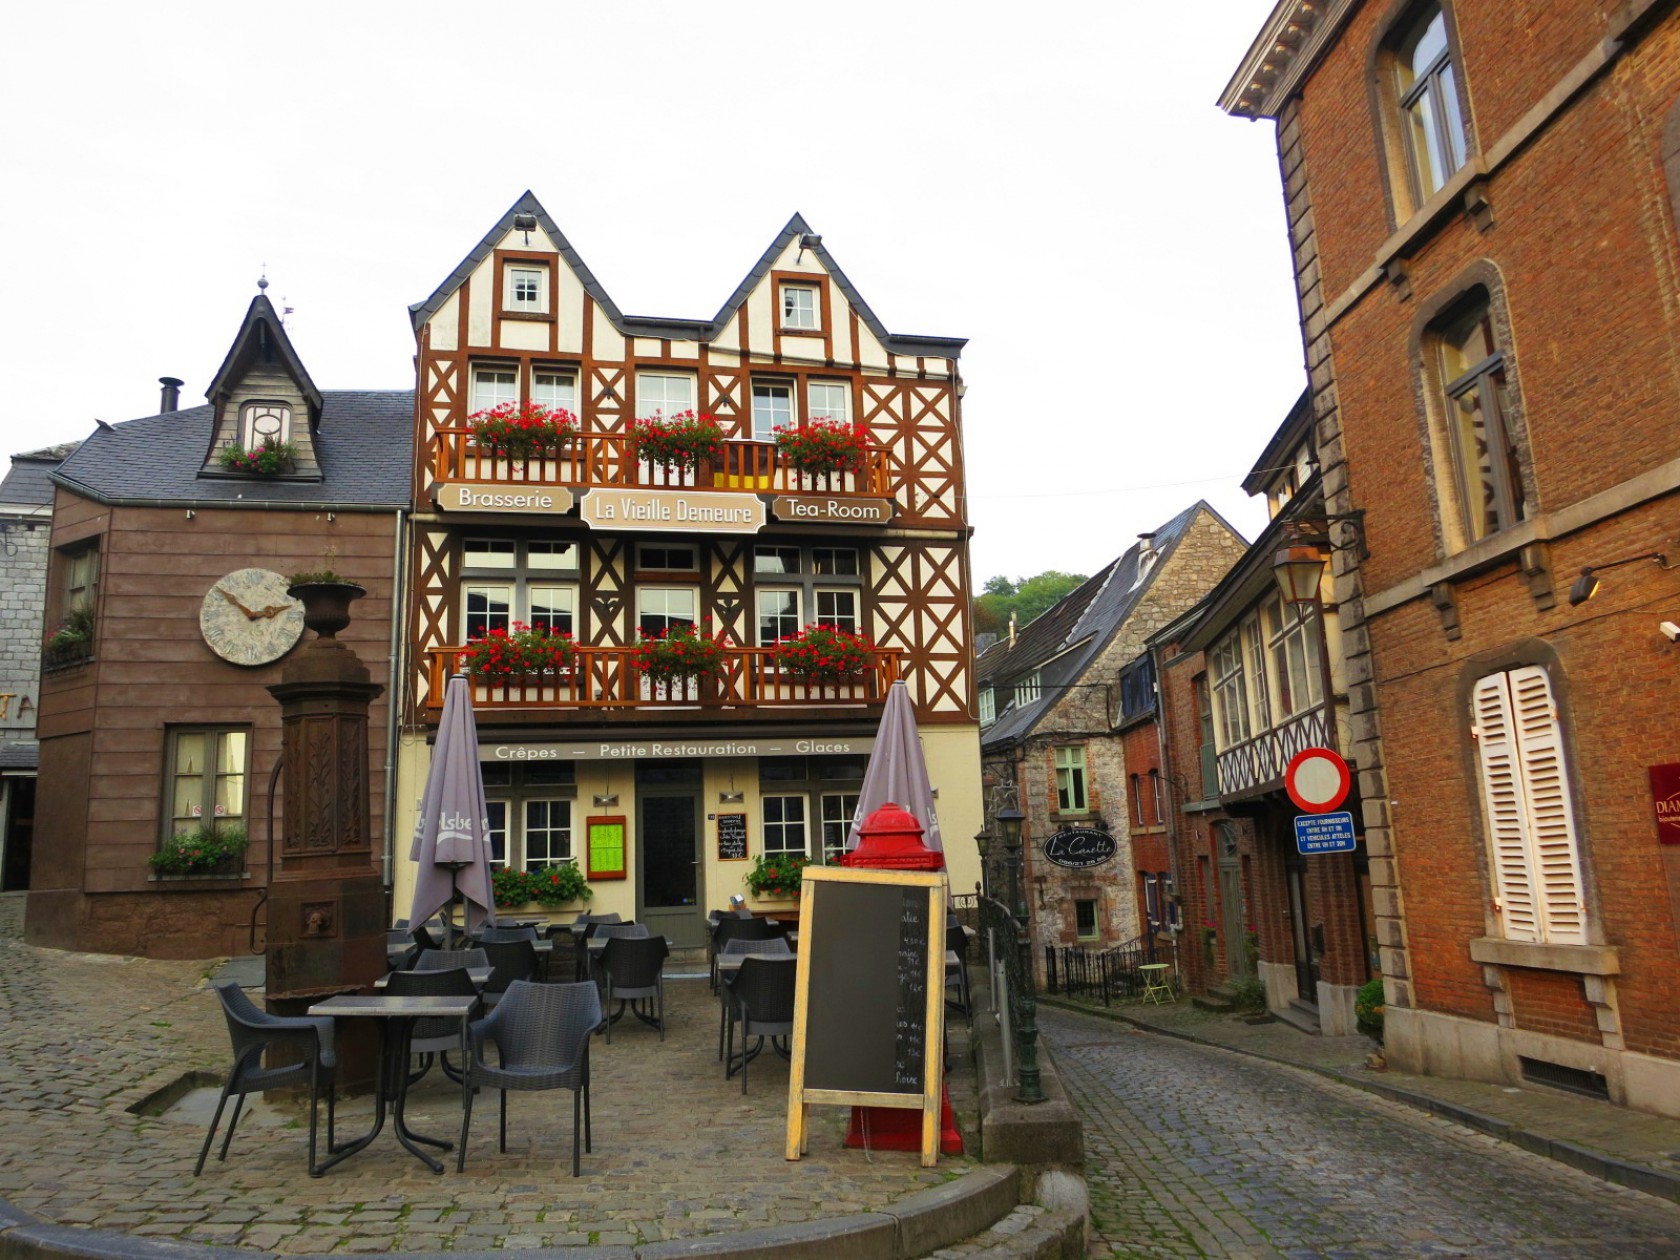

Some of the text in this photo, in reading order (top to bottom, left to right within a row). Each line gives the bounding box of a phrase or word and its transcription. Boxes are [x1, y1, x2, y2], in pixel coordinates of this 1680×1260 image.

[459, 487, 553, 508] Brasserie
[595, 496, 752, 523] La Vieille Demeure
[786, 499, 880, 519] Tea-Room
[495, 746, 558, 760] Crêpes
[600, 744, 646, 757] Petite
[652, 742, 757, 757] Restauration
[795, 740, 851, 753] Glaces
[1058, 830, 1103, 839] RESTAURANT
[1049, 836, 1066, 856] La
